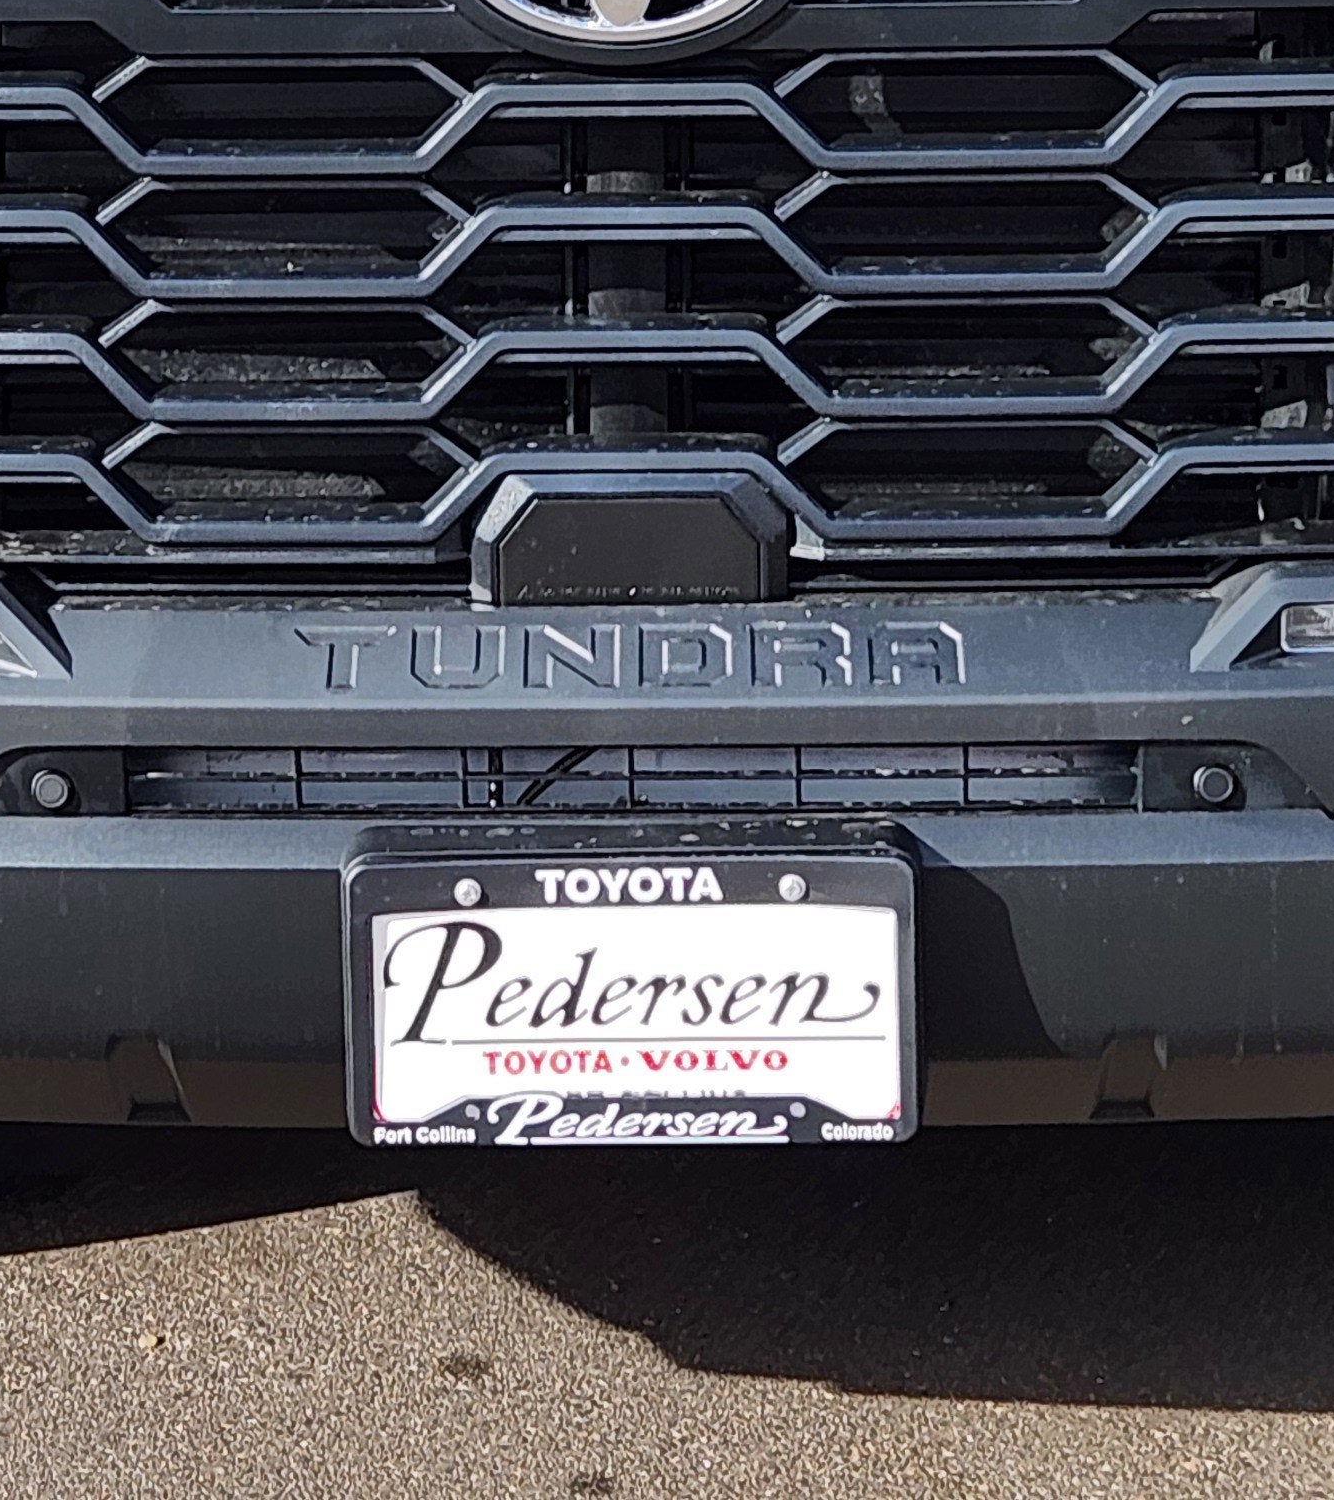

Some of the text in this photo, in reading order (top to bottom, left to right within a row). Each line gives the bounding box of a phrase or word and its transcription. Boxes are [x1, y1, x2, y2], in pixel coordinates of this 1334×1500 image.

[294, 622, 967, 690] TUNDRA
[534, 867, 724, 904] TOYOTA
[383, 920, 882, 1046] Pedersen
[483, 1049, 789, 1076] TOYOTA VOLVO
[415, 1125, 477, 1144] Collins
[486, 1090, 788, 1145] Pedersen
[820, 1121, 895, 1142] Colorado
